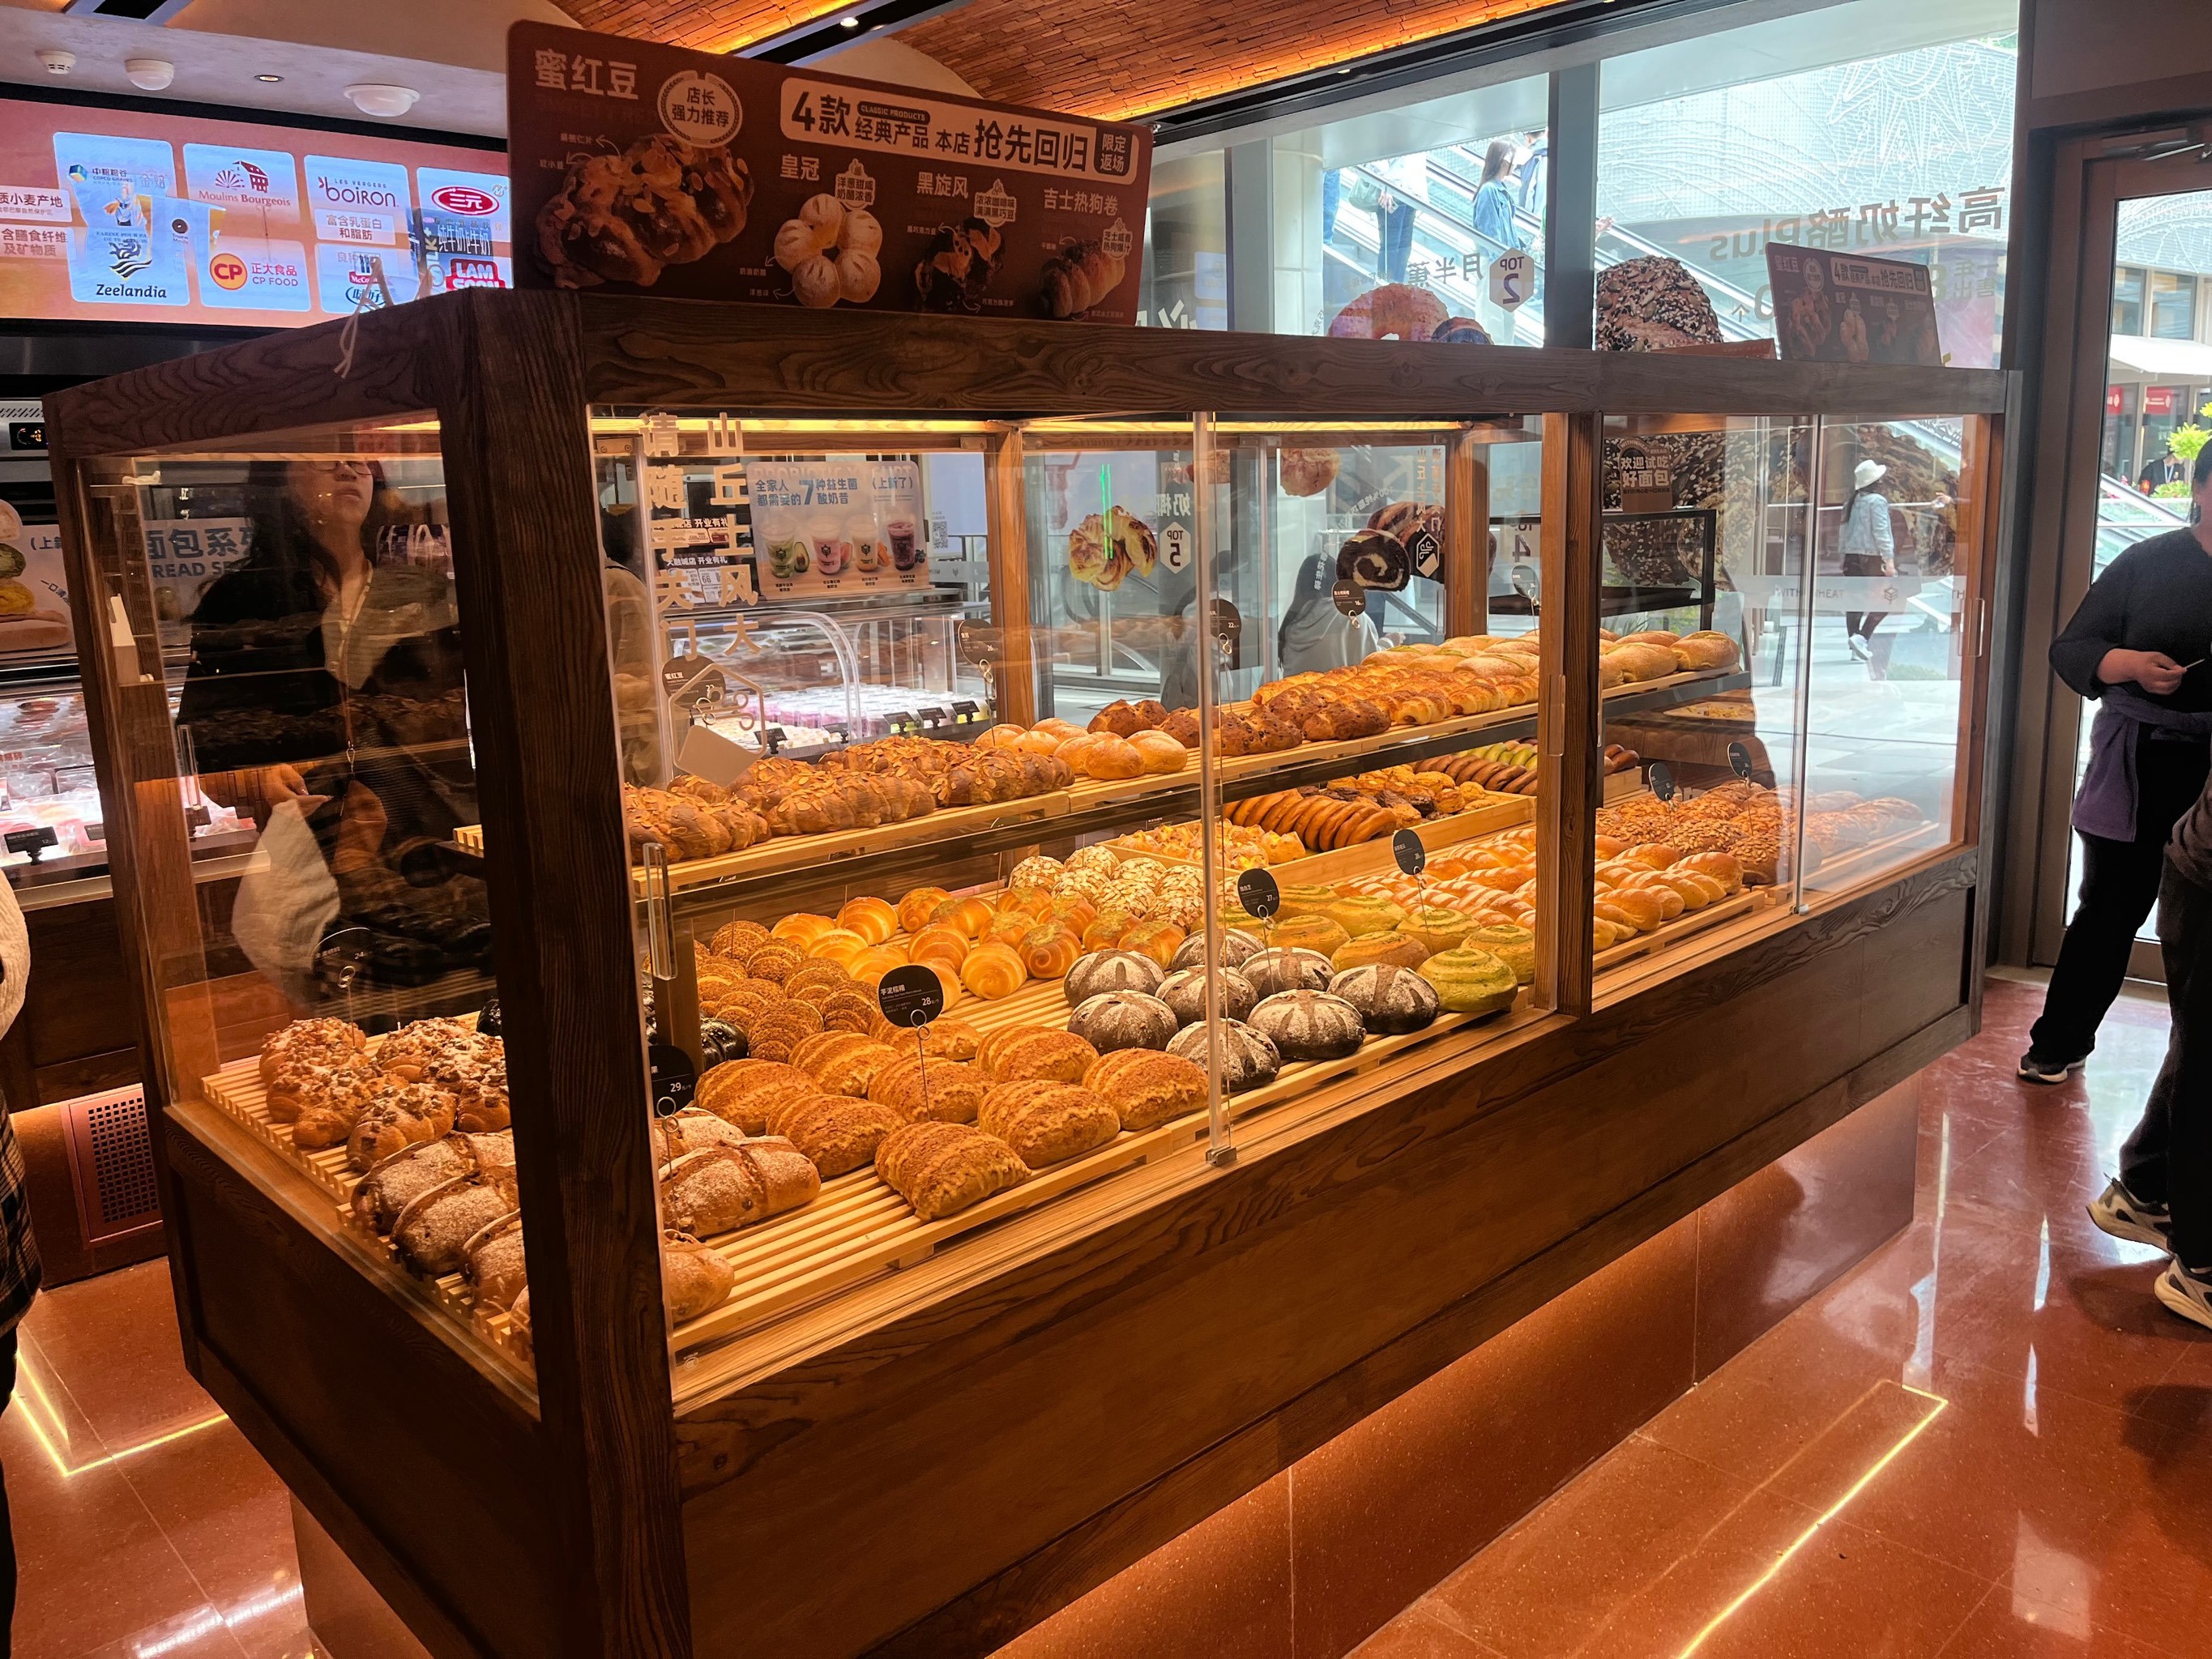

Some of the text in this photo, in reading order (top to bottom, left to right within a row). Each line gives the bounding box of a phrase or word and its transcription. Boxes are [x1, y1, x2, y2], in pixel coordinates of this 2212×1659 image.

[535, 49, 638, 100] 蜜红豆
[686, 87, 715, 106] 店长
[672, 104, 729, 128] 强力推荐
[860, 104, 925, 122] CLASSIC PRODUCTS
[791, 90, 1089, 172] 4款 经典产品 本店 抢先回归
[1102, 134, 1127, 153] 限定
[779, 152, 820, 181] 皇冠
[1100, 153, 1125, 173] 返场
[916, 171, 969, 199] 黑旋风
[0, 192, 63, 208] 质小麦产地
[199, 190, 292, 207] Moulins Bourgeois
[449, 193, 483, 210] 三元
[836, 189, 873, 203] 奶酪浓香
[1043, 186, 1119, 217] 吉士热狗卷
[326, 215, 382, 229] 富含乳蛋白
[339, 228, 373, 241] 和脂肪
[4, 242, 57, 257] 及矿物质
[214, 263, 243, 280] CP
[251, 262, 297, 276] 正大食品
[455, 261, 494, 279] LAM
[252, 276, 298, 287] CP FOOD
[96, 284, 167, 298] Zeelandia
[1621, 456, 1669, 470] 欢迎试吃
[755, 480, 789, 493] 全家人
[815, 478, 858, 491] 种益生菌
[1621, 470, 1669, 488] 好面包
[757, 493, 802, 507] 都需要的
[799, 479, 813, 505] 7
[817, 493, 849, 505] 酸奶昔
[638, 412, 699, 664] 请随手关门
[707, 412, 762, 656] 山丘上风大
[670, 1081, 681, 1093] 29
